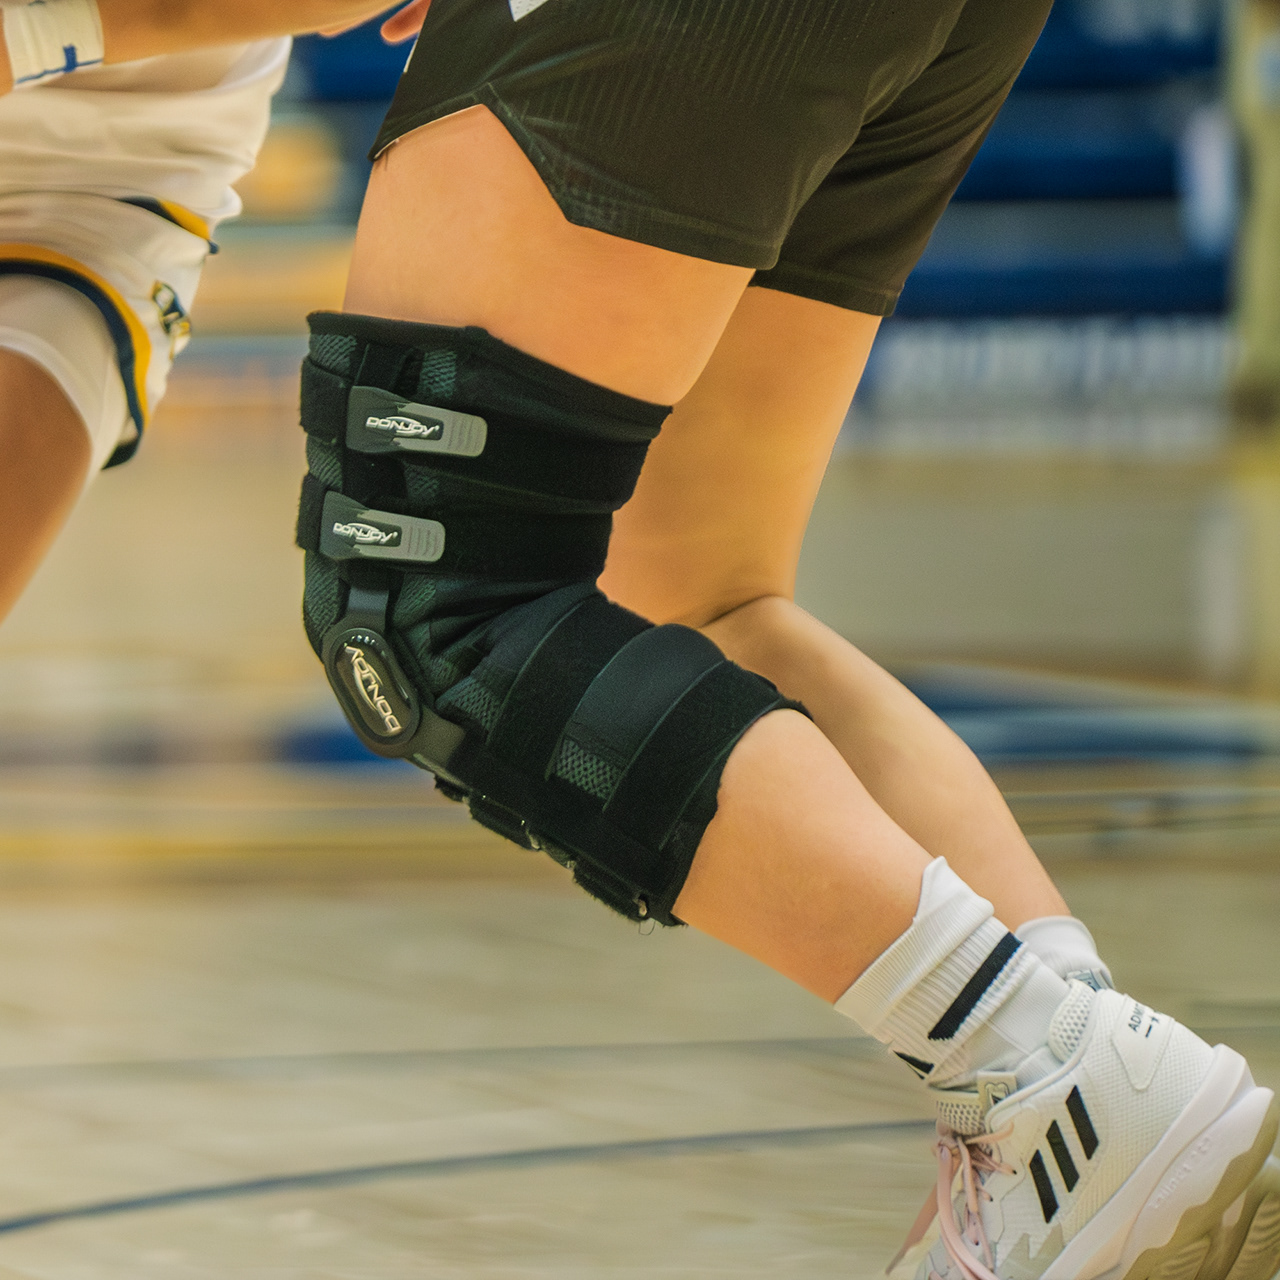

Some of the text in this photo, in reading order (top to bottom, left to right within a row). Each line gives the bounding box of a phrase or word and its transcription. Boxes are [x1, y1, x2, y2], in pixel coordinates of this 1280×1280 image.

[365, 416, 440, 438] DONJOY
[332, 522, 398, 545] DONJOY
[345, 646, 402, 733] DONJOY
